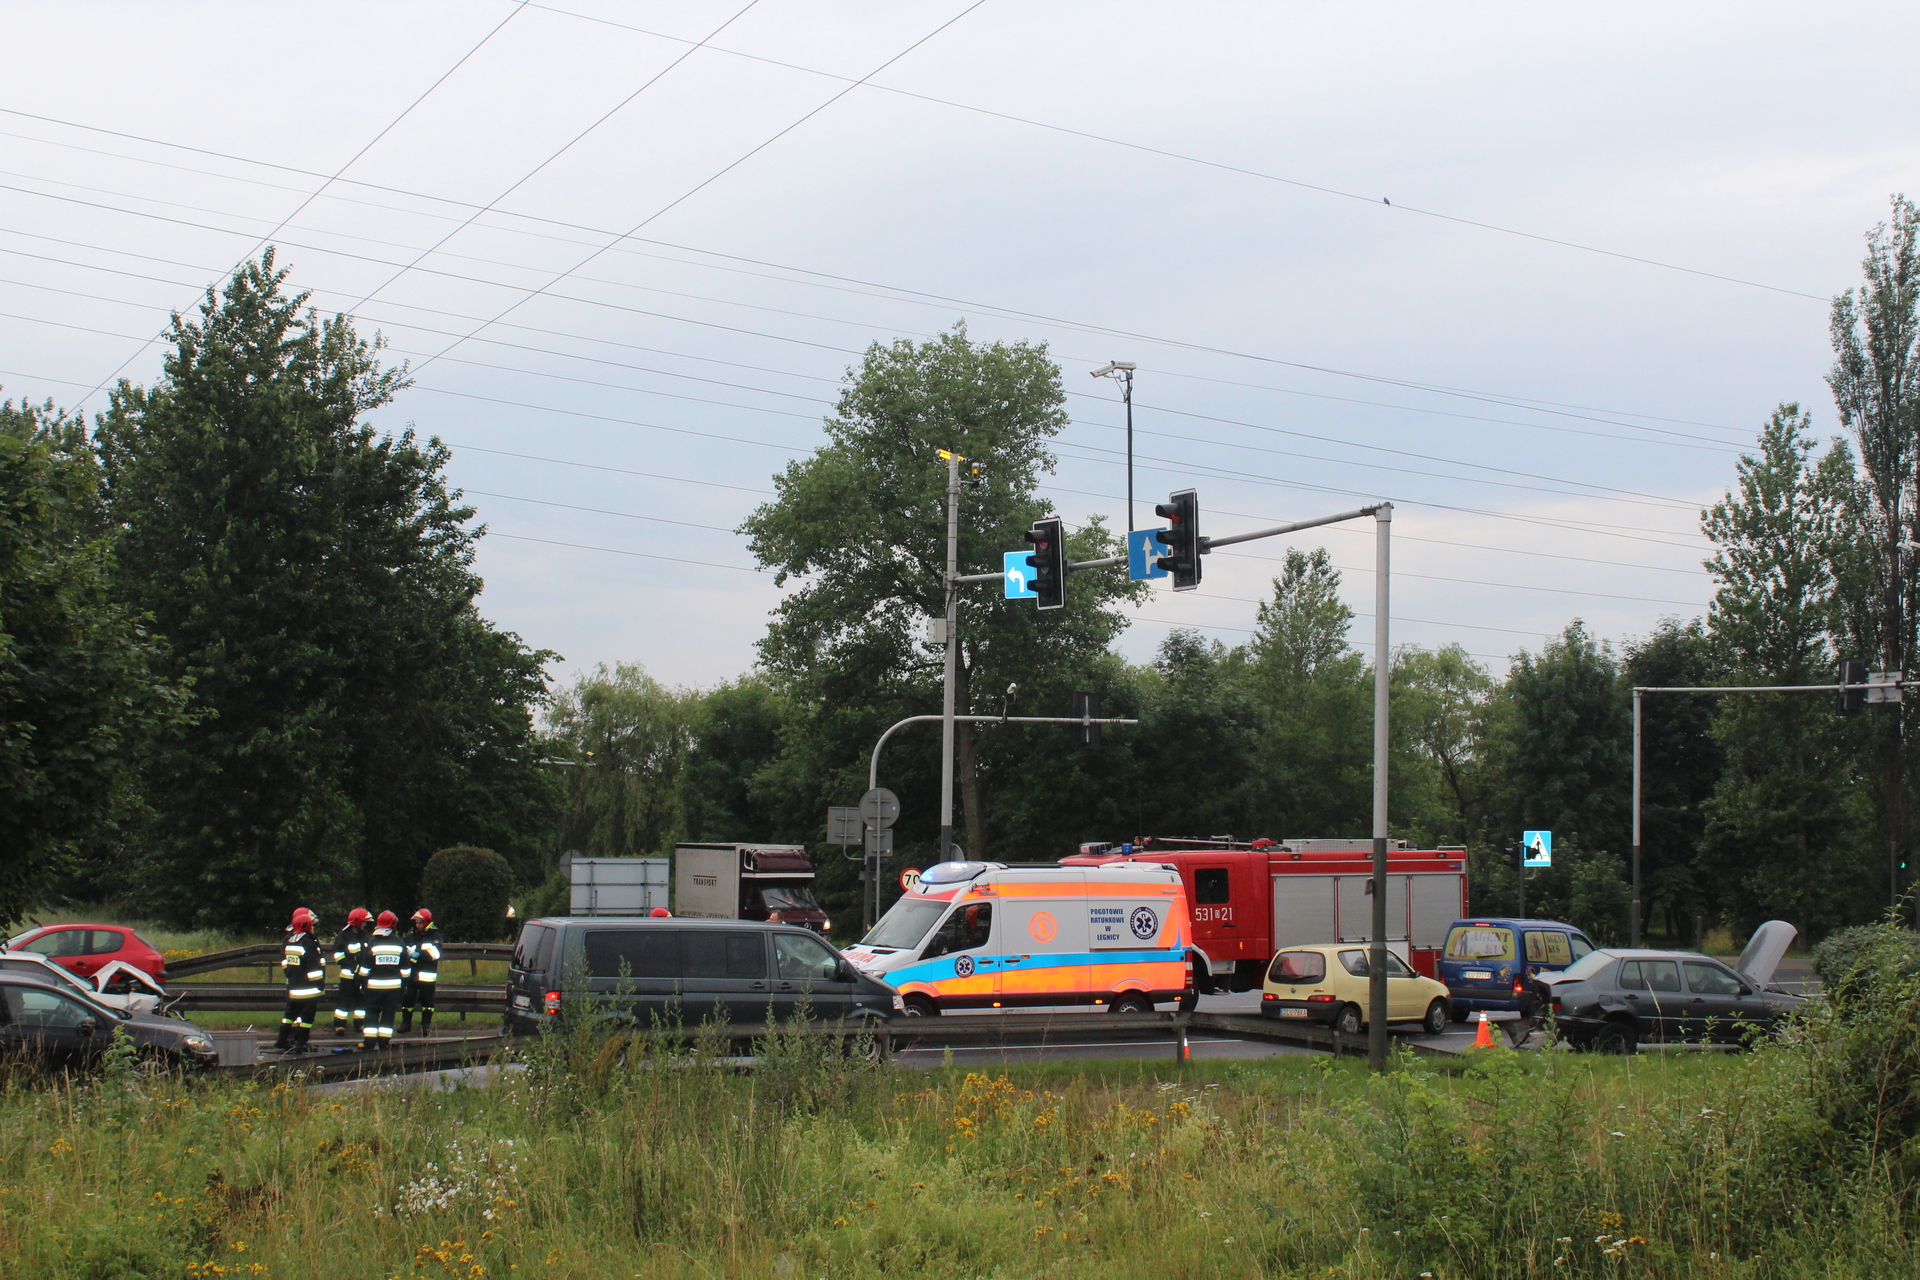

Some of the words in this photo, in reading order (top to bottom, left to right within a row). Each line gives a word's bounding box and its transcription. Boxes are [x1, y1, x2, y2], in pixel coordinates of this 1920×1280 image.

[693, 878, 717, 886] TRANSPORT
[904, 874, 920, 886] 70
[1195, 907, 1213, 921] 531
[1221, 907, 1232, 920] 21
[1546, 934, 1566, 944] AGENT
